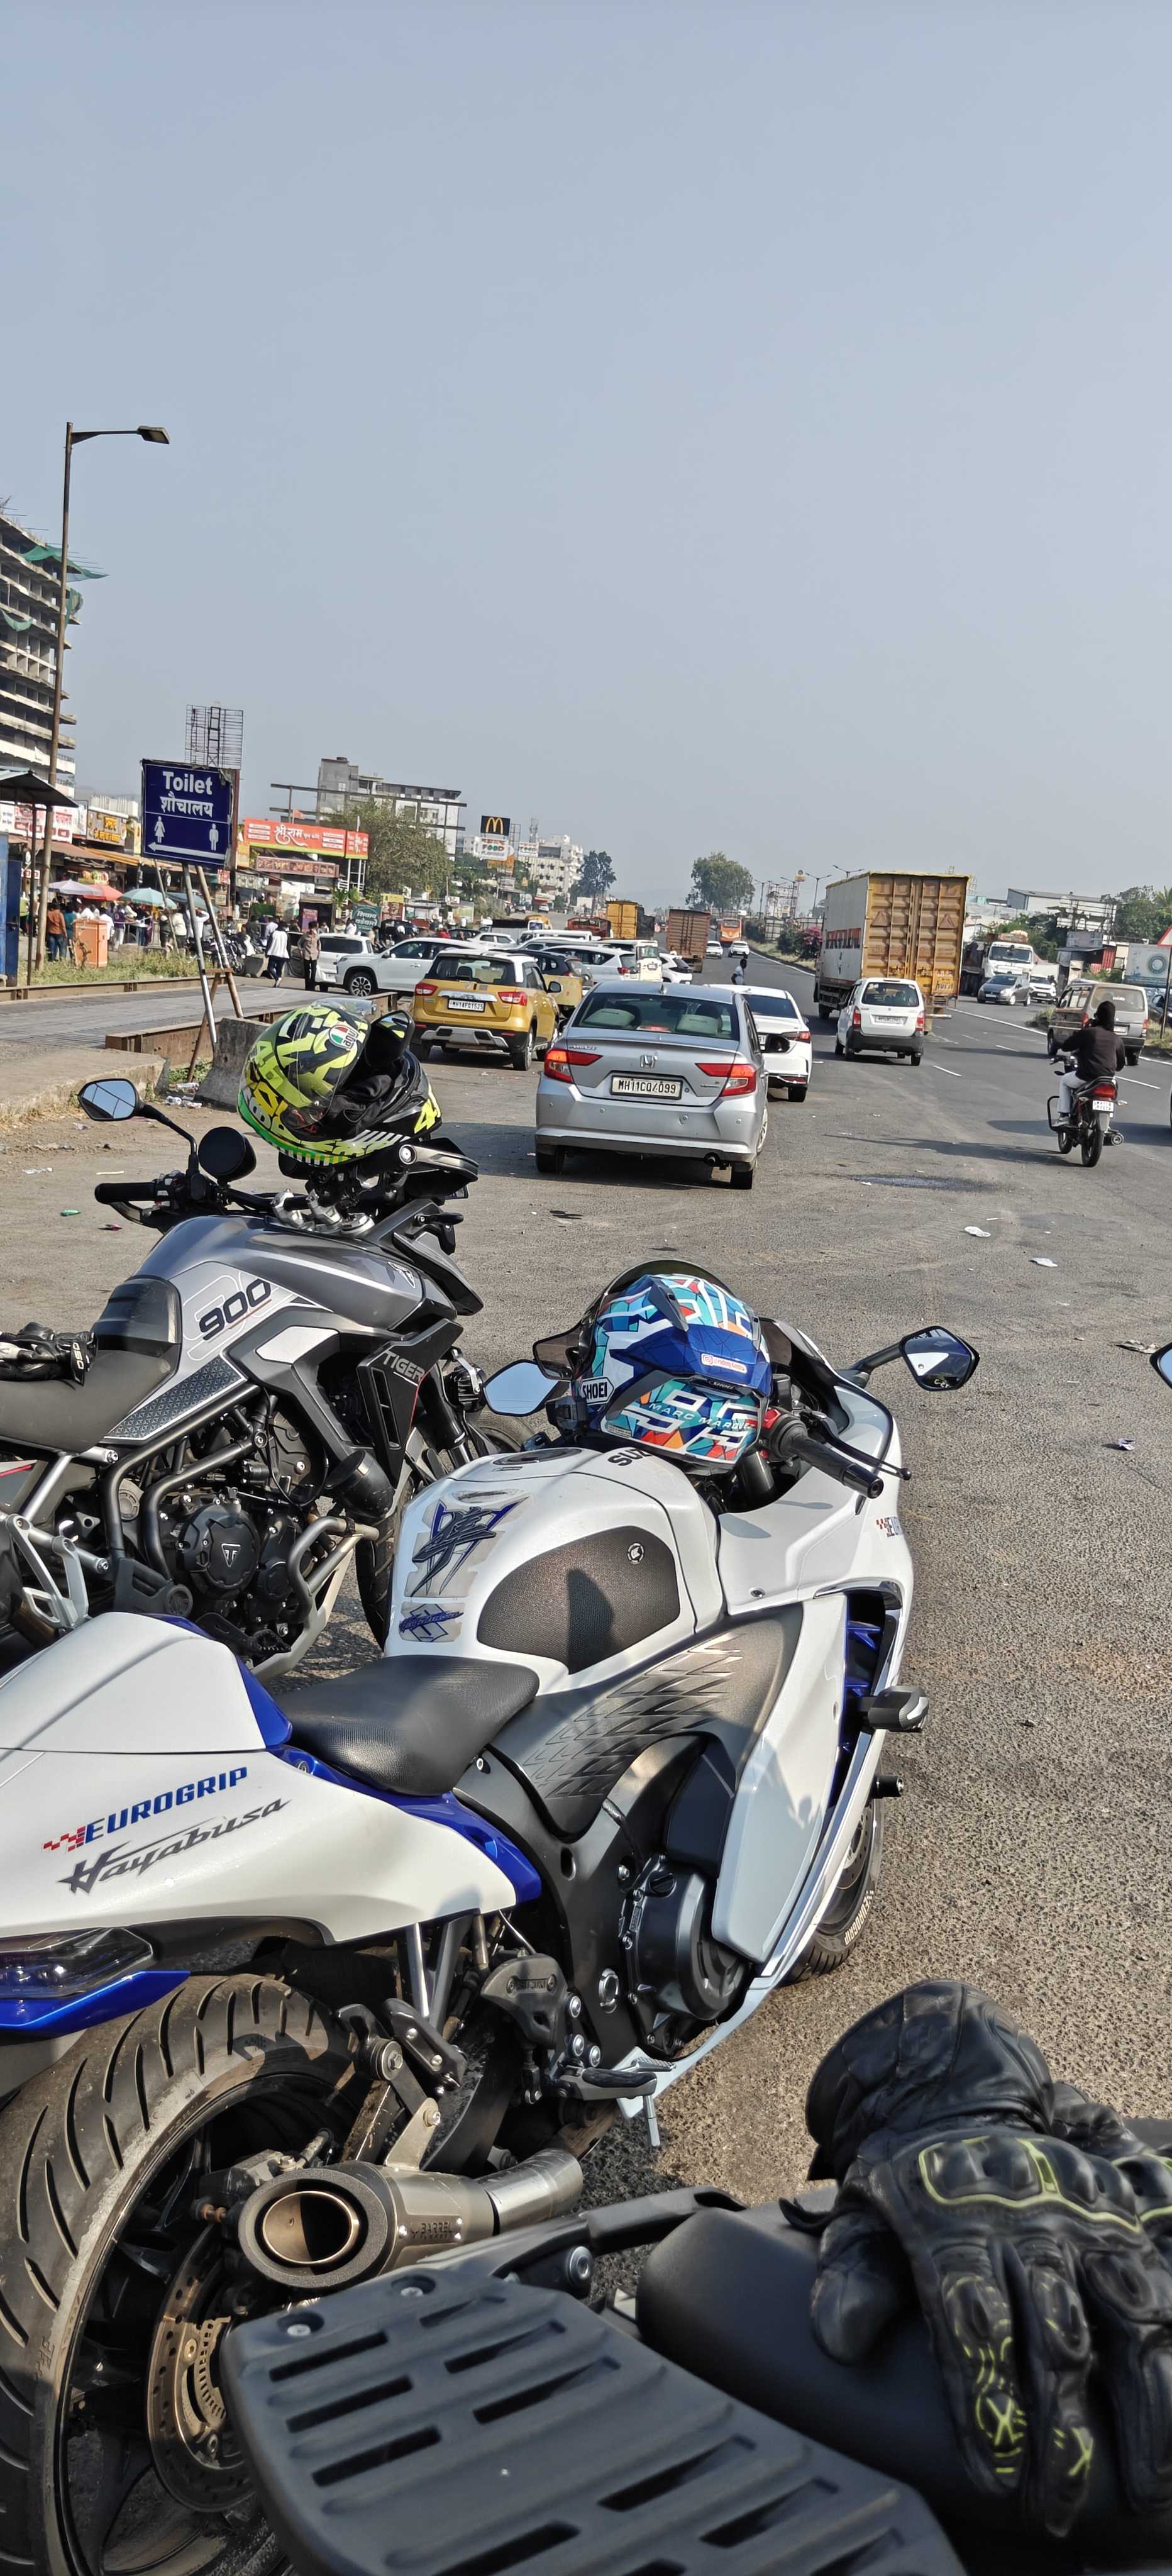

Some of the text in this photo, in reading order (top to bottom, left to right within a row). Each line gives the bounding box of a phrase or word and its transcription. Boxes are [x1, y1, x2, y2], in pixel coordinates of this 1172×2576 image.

[162, 771, 213, 795] Toilet
[160, 791, 214, 818] शौचालय
[199, 1278, 271, 1341] 900
[383, 1350, 425, 1382] TIGER
[582, 1381, 608, 1400] SHOEI
[648, 1403, 695, 1420] MARC
[607, 1447, 653, 1467] SUZ
[85, 1767, 247, 1844] EUROGRIP
[57, 1799, 292, 1895] Hayabusa
[844, 1895, 870, 1946] EUROGRIP
